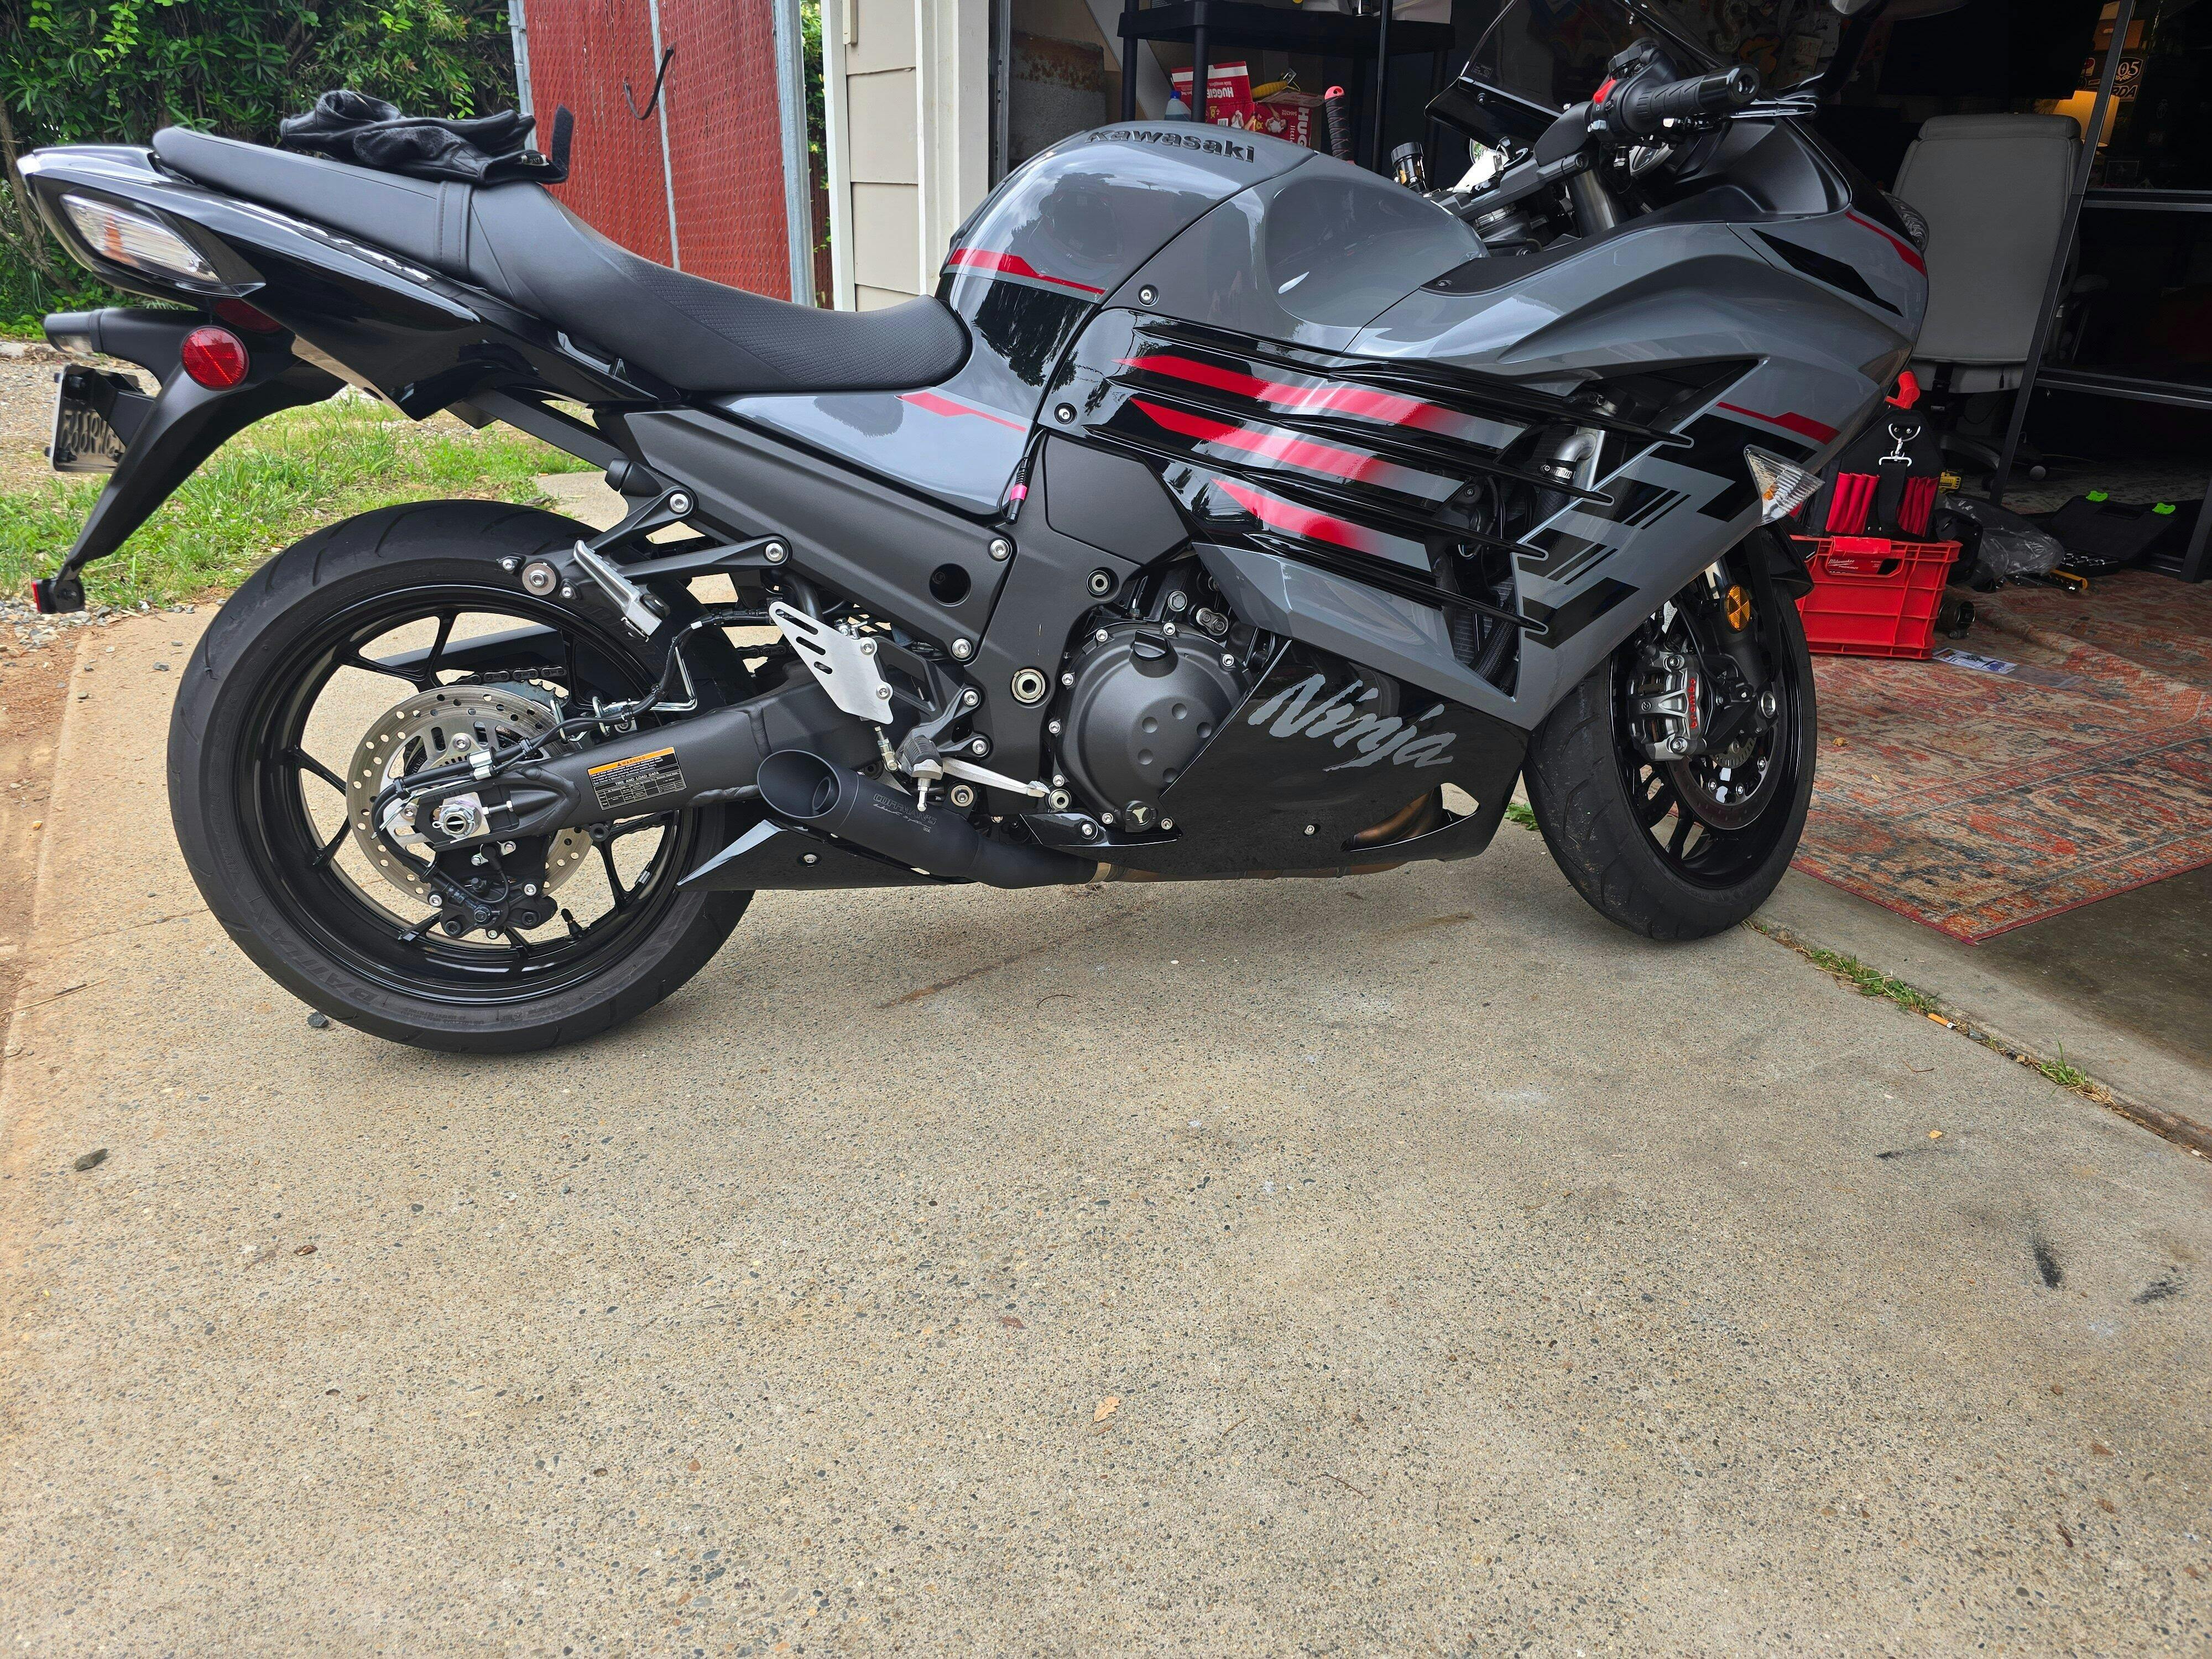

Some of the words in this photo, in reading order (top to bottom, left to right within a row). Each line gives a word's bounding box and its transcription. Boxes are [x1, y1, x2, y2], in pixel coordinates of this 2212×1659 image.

[2117, 61, 2140, 76] 05
[1207, 87, 1234, 98] HUGGIE
[1084, 130, 1254, 163] Kawasaki
[1688, 678, 1697, 728] brembo
[1248, 674, 1457, 772] Ninja
[622, 756, 646, 765] WARNING
[873, 793, 937, 825] COFFMAN'S
